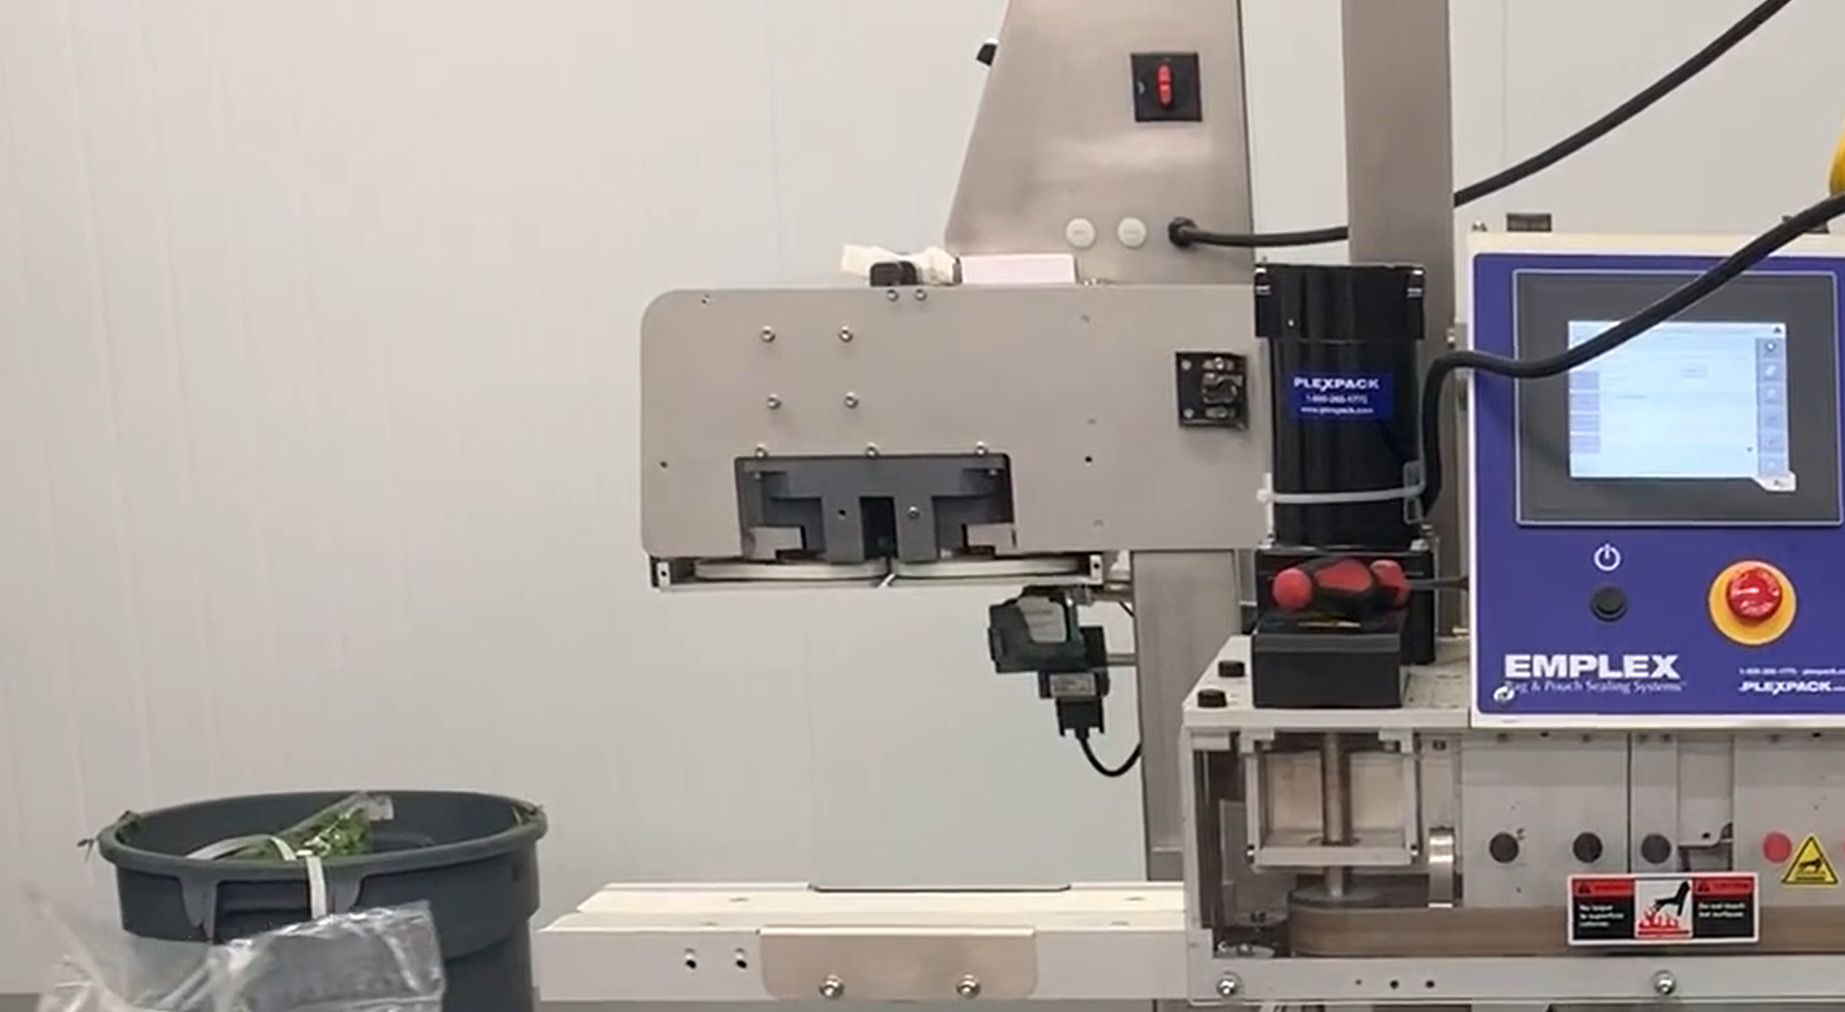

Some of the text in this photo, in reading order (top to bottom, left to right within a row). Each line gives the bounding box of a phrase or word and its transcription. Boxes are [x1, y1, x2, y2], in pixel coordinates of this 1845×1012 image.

[1293, 377, 1379, 392] PLEXPACK
[1505, 654, 1681, 679] EMPLEX
[1739, 680, 1832, 696] PLEXPACK
